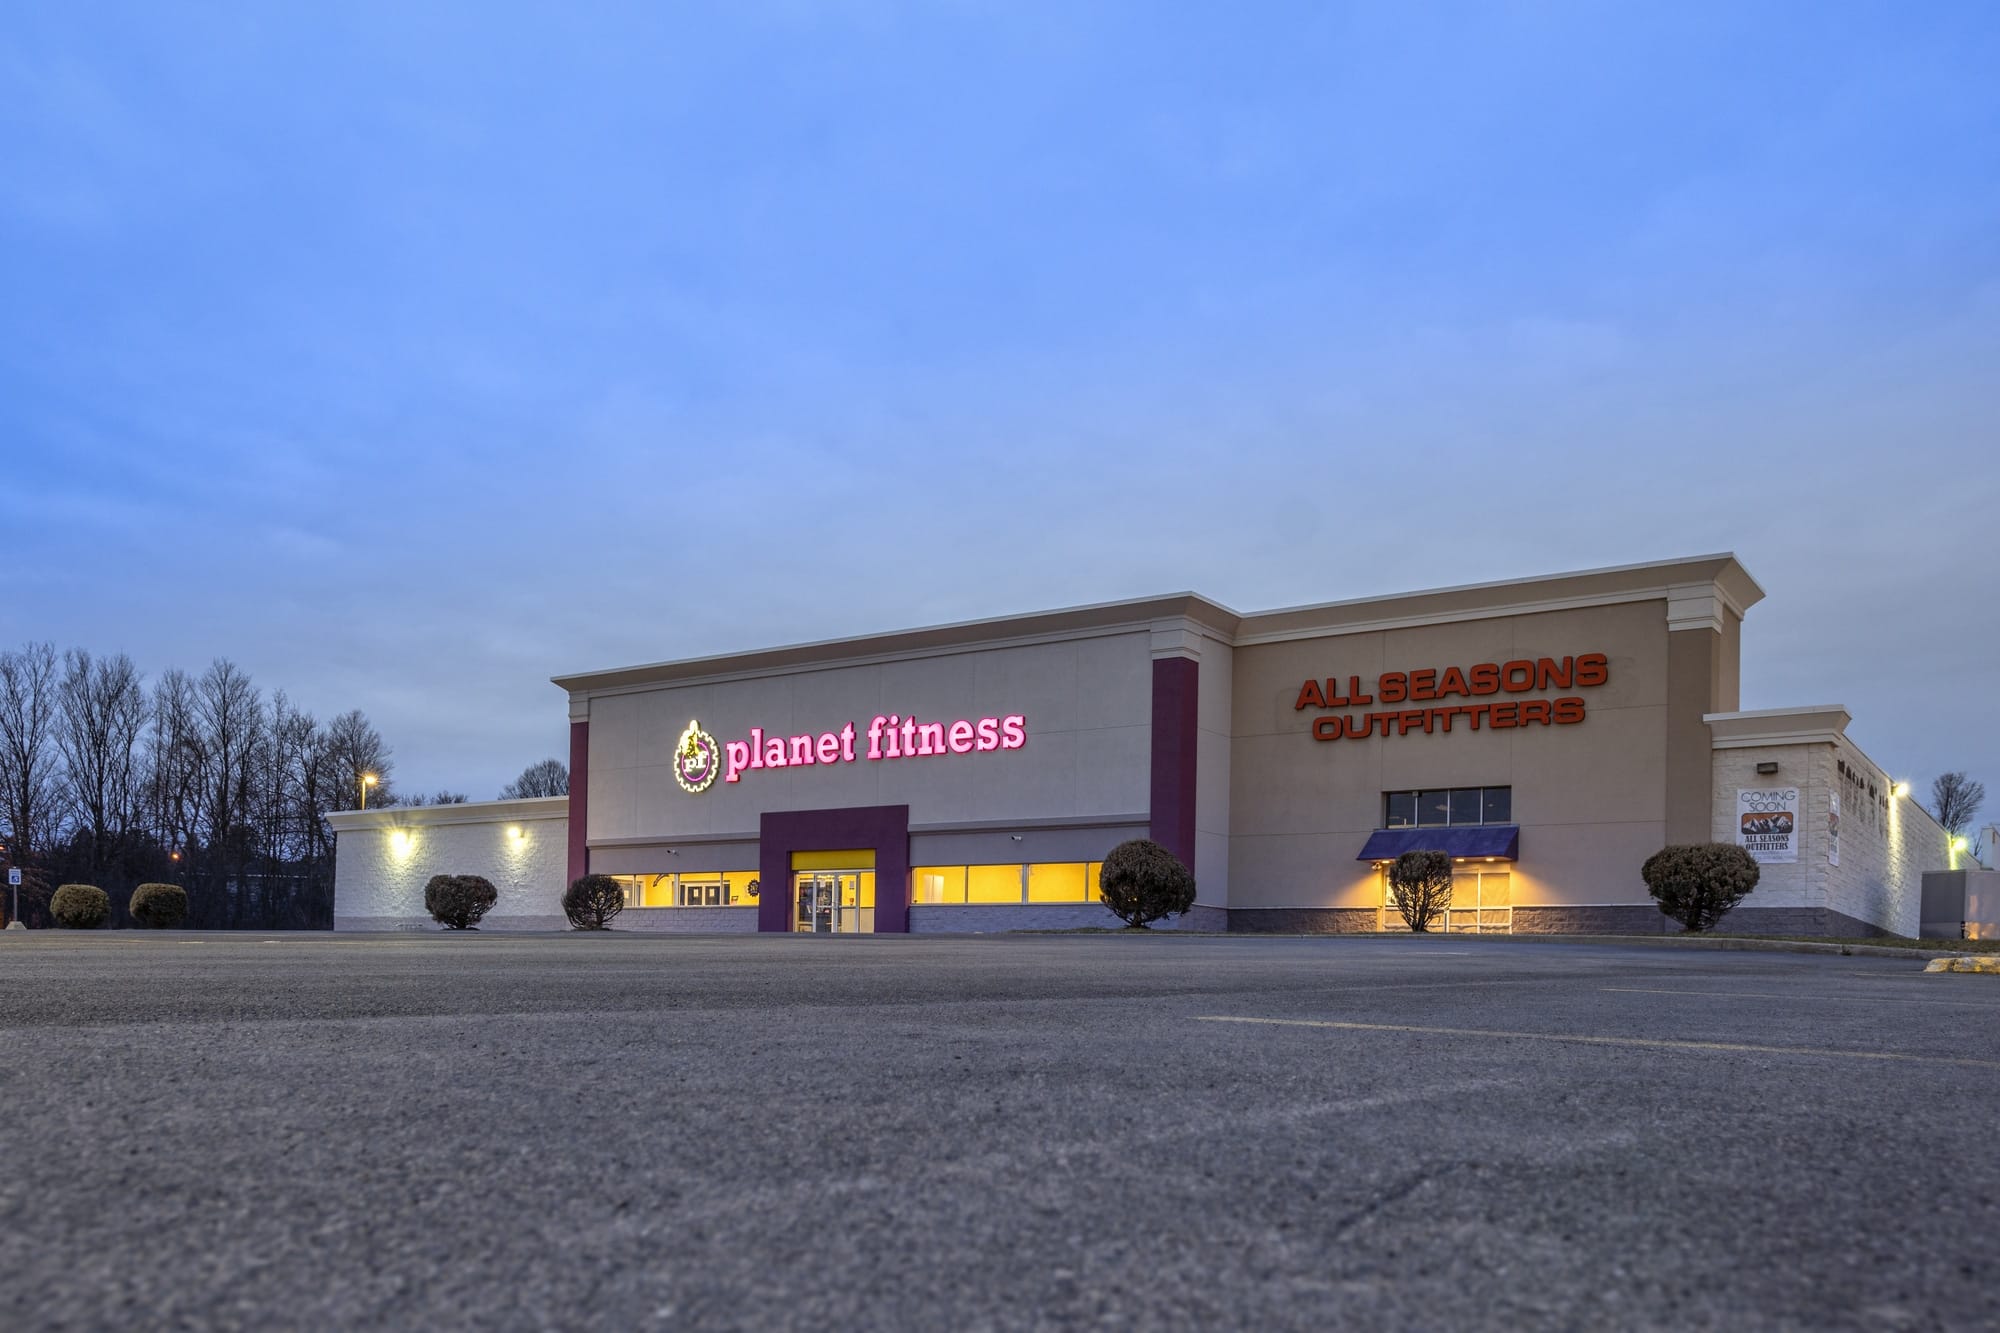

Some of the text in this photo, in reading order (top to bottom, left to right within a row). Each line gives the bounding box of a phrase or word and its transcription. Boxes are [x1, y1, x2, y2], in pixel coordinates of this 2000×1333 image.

[1295, 653, 1608, 711] ALL SEASONS
[1312, 697, 1586, 741] OUTFITTERS
[725, 713, 1027, 782] planet fitness
[684, 751, 708, 772] pf
[1741, 790, 1795, 802] COMING
[1749, 801, 1786, 812] SOON
[1745, 834, 1789, 843] ALL SEASONS
[1745, 842, 1788, 851] OUTFITTERS
